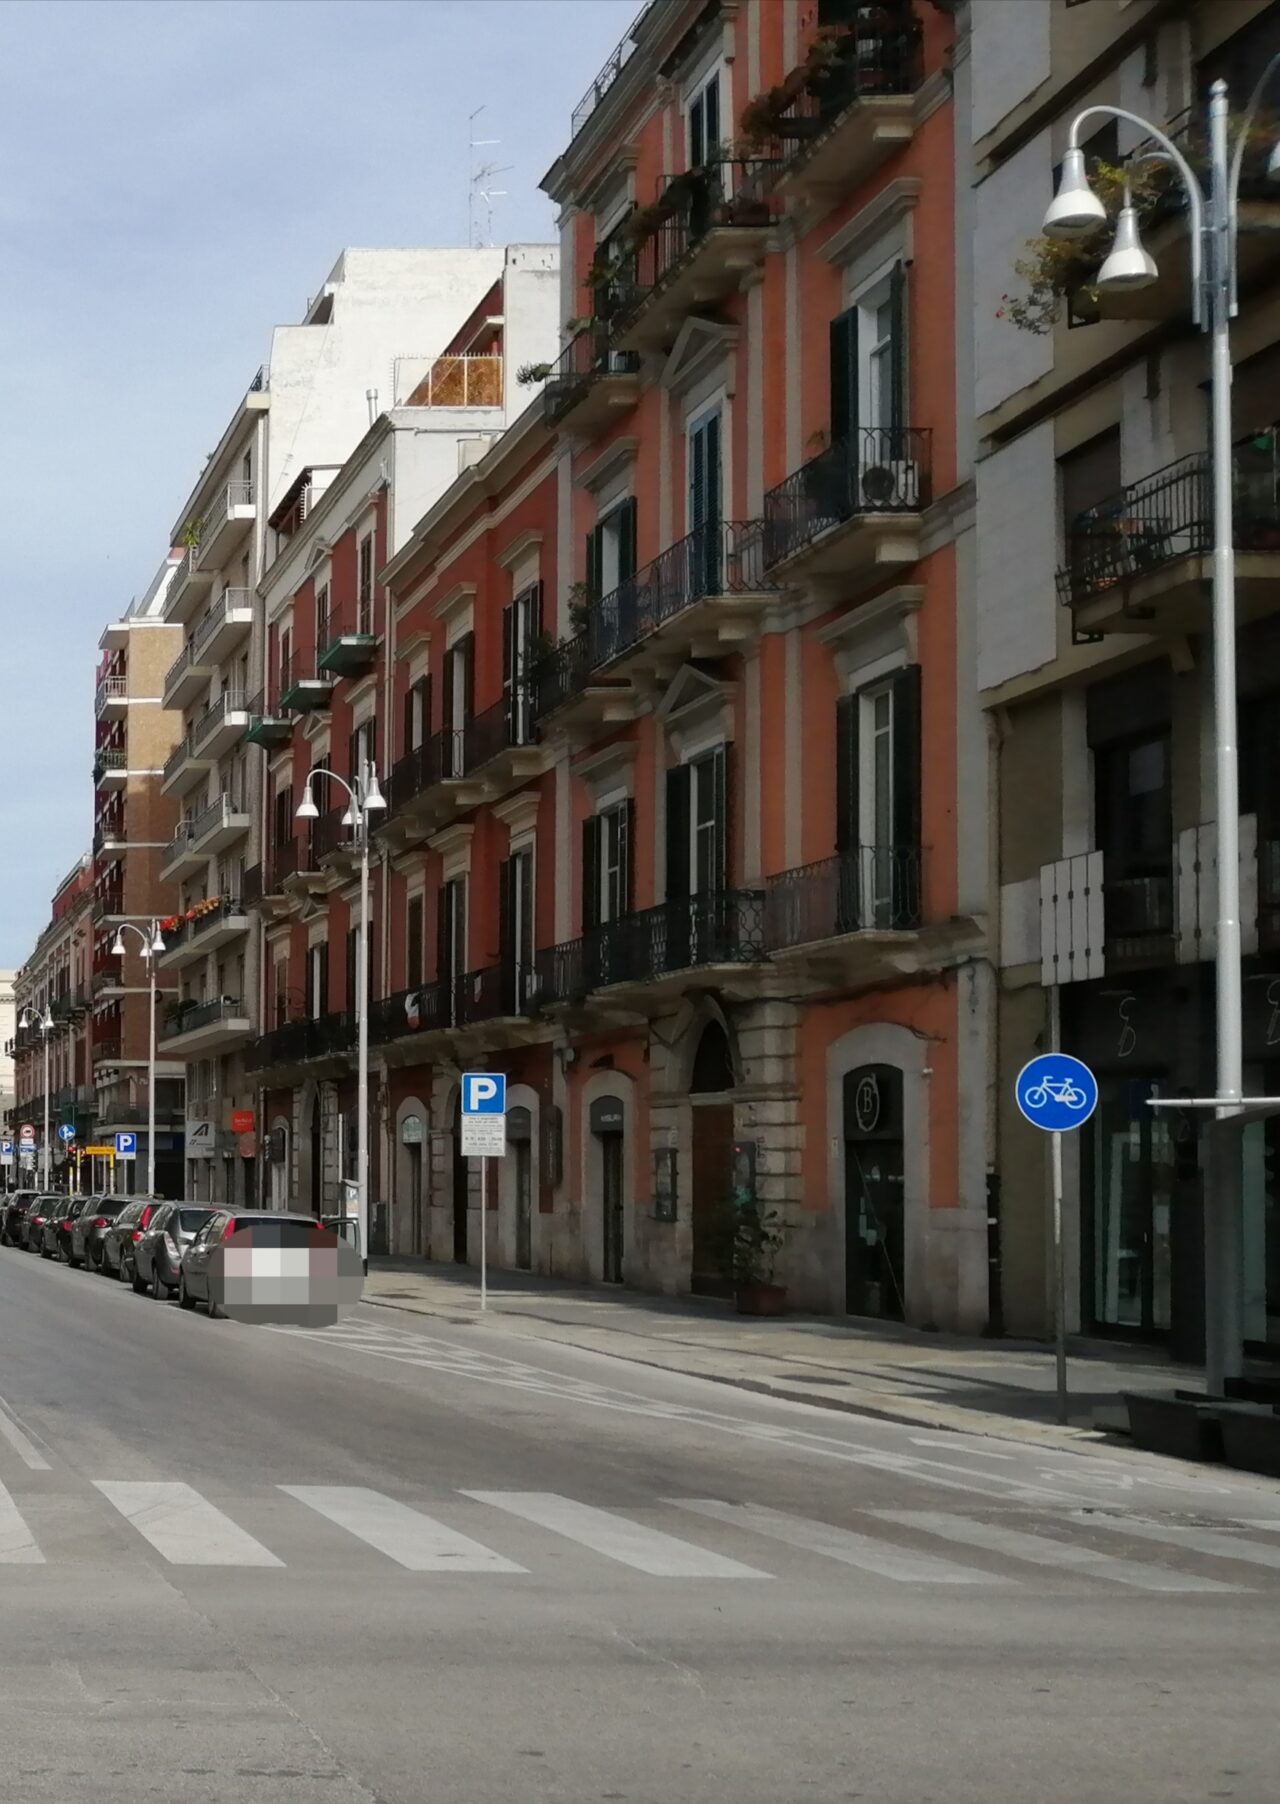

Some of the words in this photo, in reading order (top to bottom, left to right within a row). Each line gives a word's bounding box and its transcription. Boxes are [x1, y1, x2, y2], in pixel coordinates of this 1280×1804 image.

[469, 1077, 497, 1111] P
[2, 1142, 10, 1152] P
[121, 1135, 133, 1151] P
